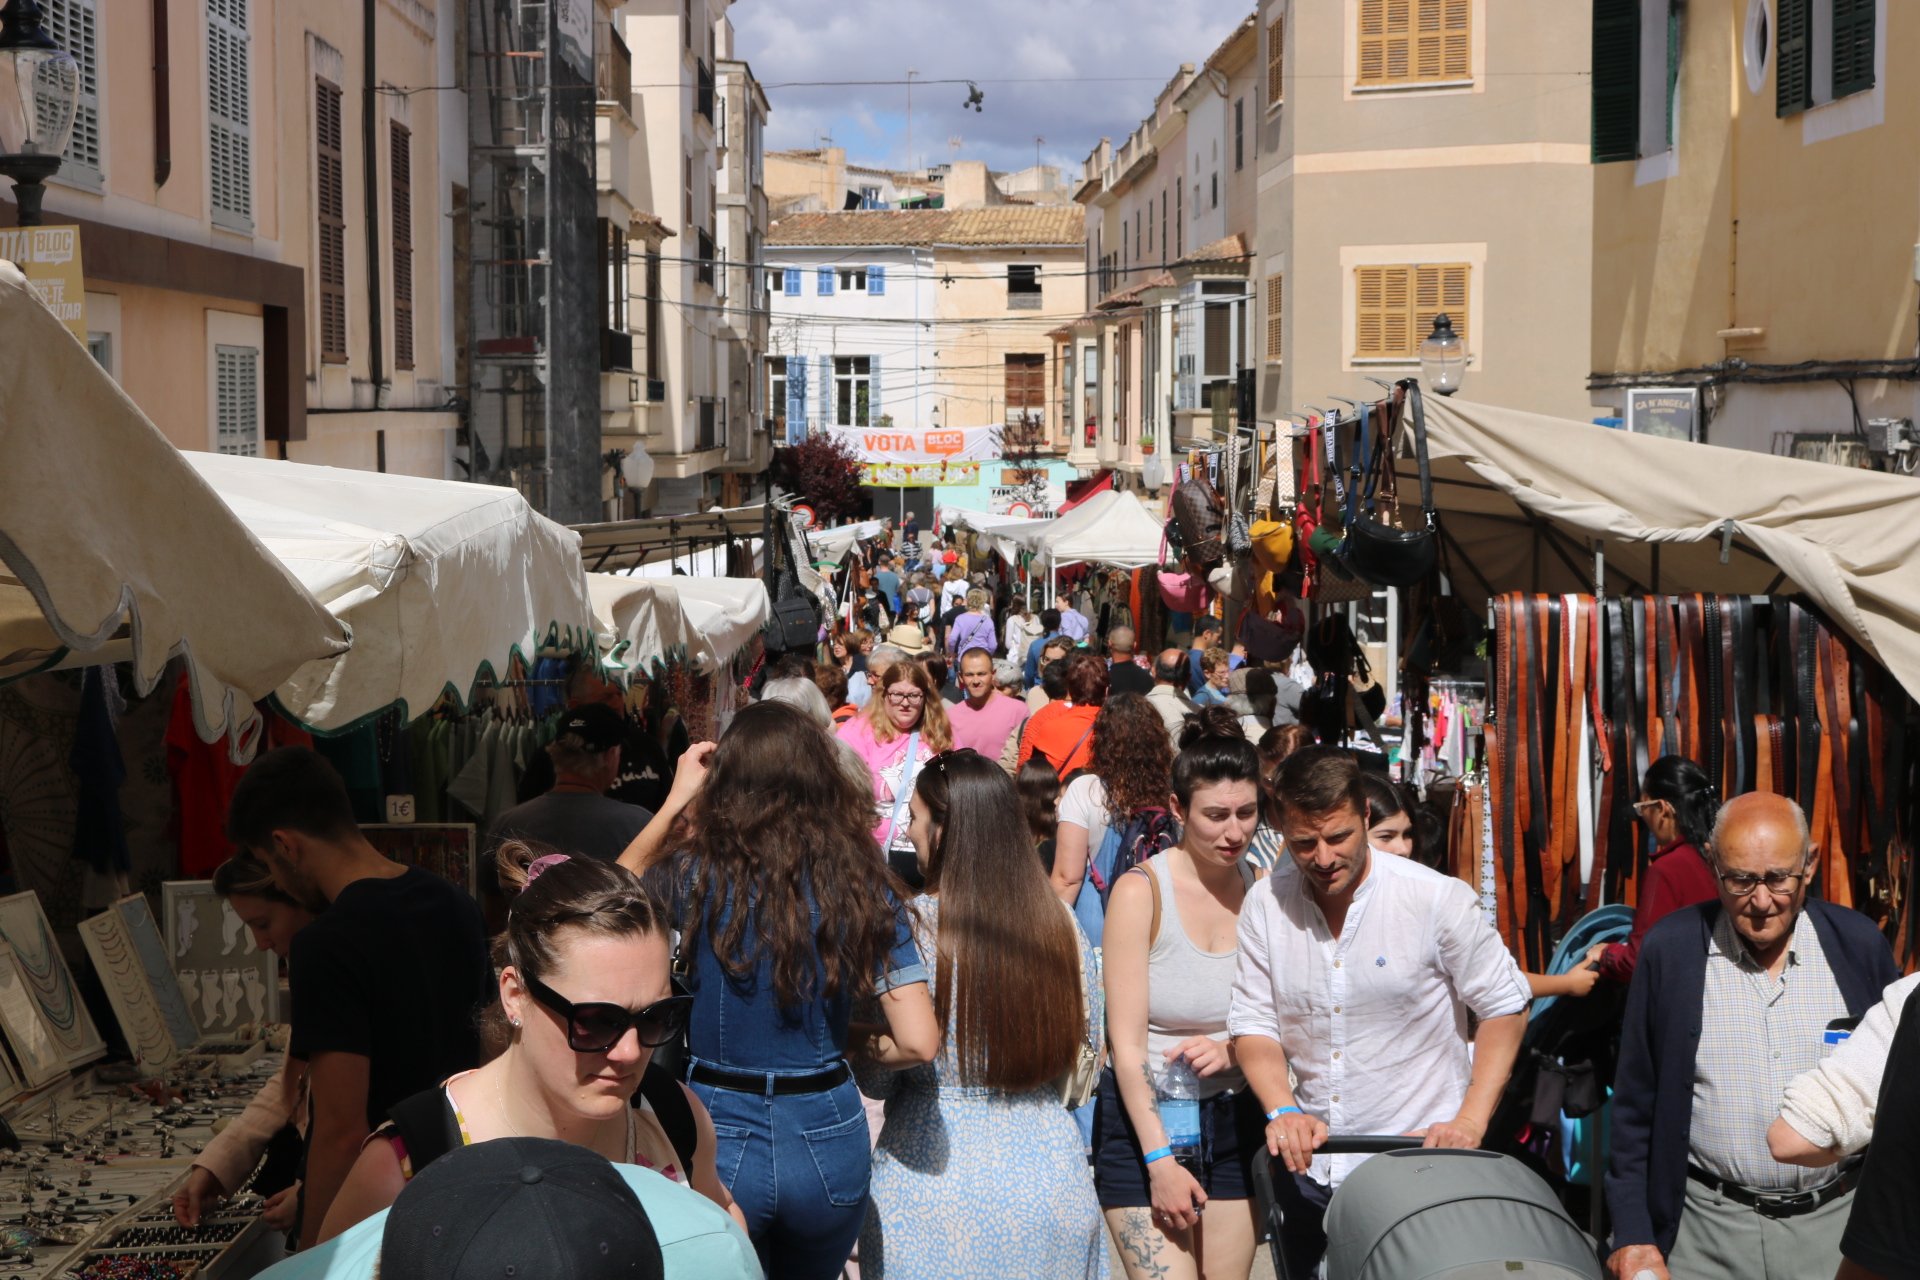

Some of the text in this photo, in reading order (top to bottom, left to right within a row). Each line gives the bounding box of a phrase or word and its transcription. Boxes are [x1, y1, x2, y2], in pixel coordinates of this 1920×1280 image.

[36, 232, 71, 252] BLOC
[1635, 401, 1647, 411] CA
[863, 433, 962, 451] VOTA BLOC
[392, 801, 410, 817] 1€
